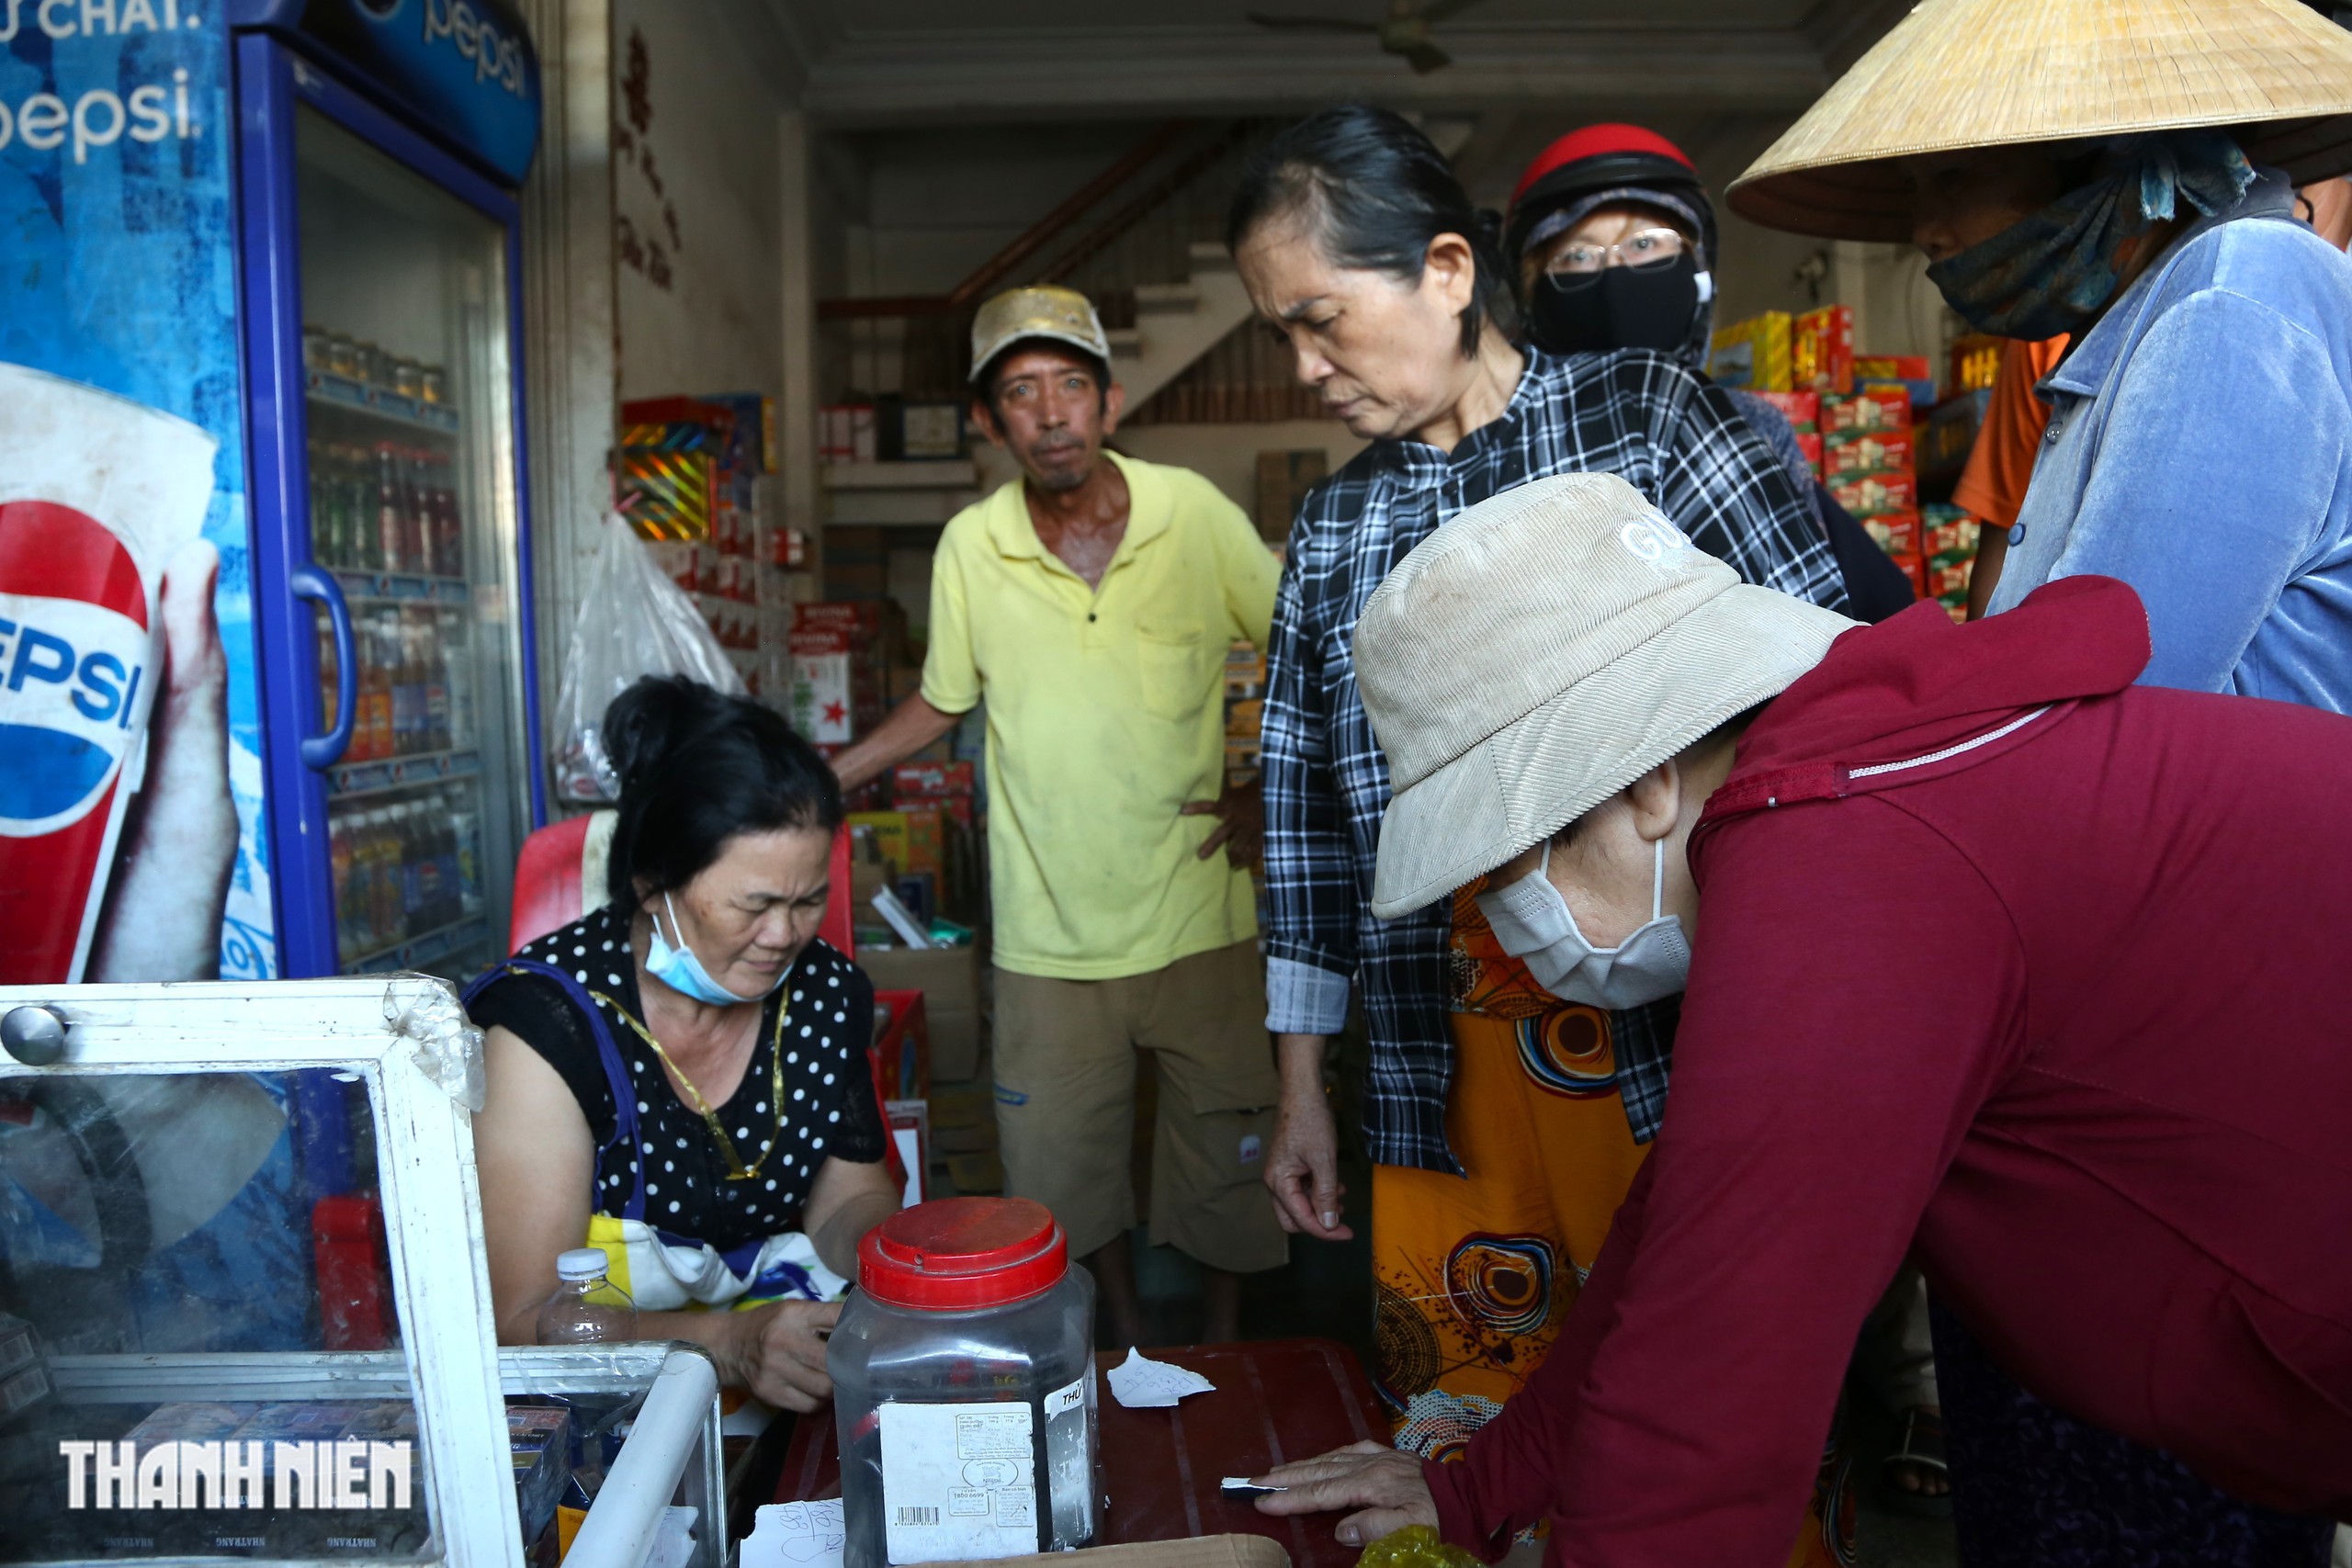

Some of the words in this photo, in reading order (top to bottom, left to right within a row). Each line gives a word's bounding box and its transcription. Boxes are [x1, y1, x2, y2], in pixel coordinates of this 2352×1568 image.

[0, 67, 189, 164] epsi
[1620, 509, 1692, 562] GU
[216, 1536, 266, 1548] NHATRANG
[327, 1536, 377, 1549] NHATRANG
